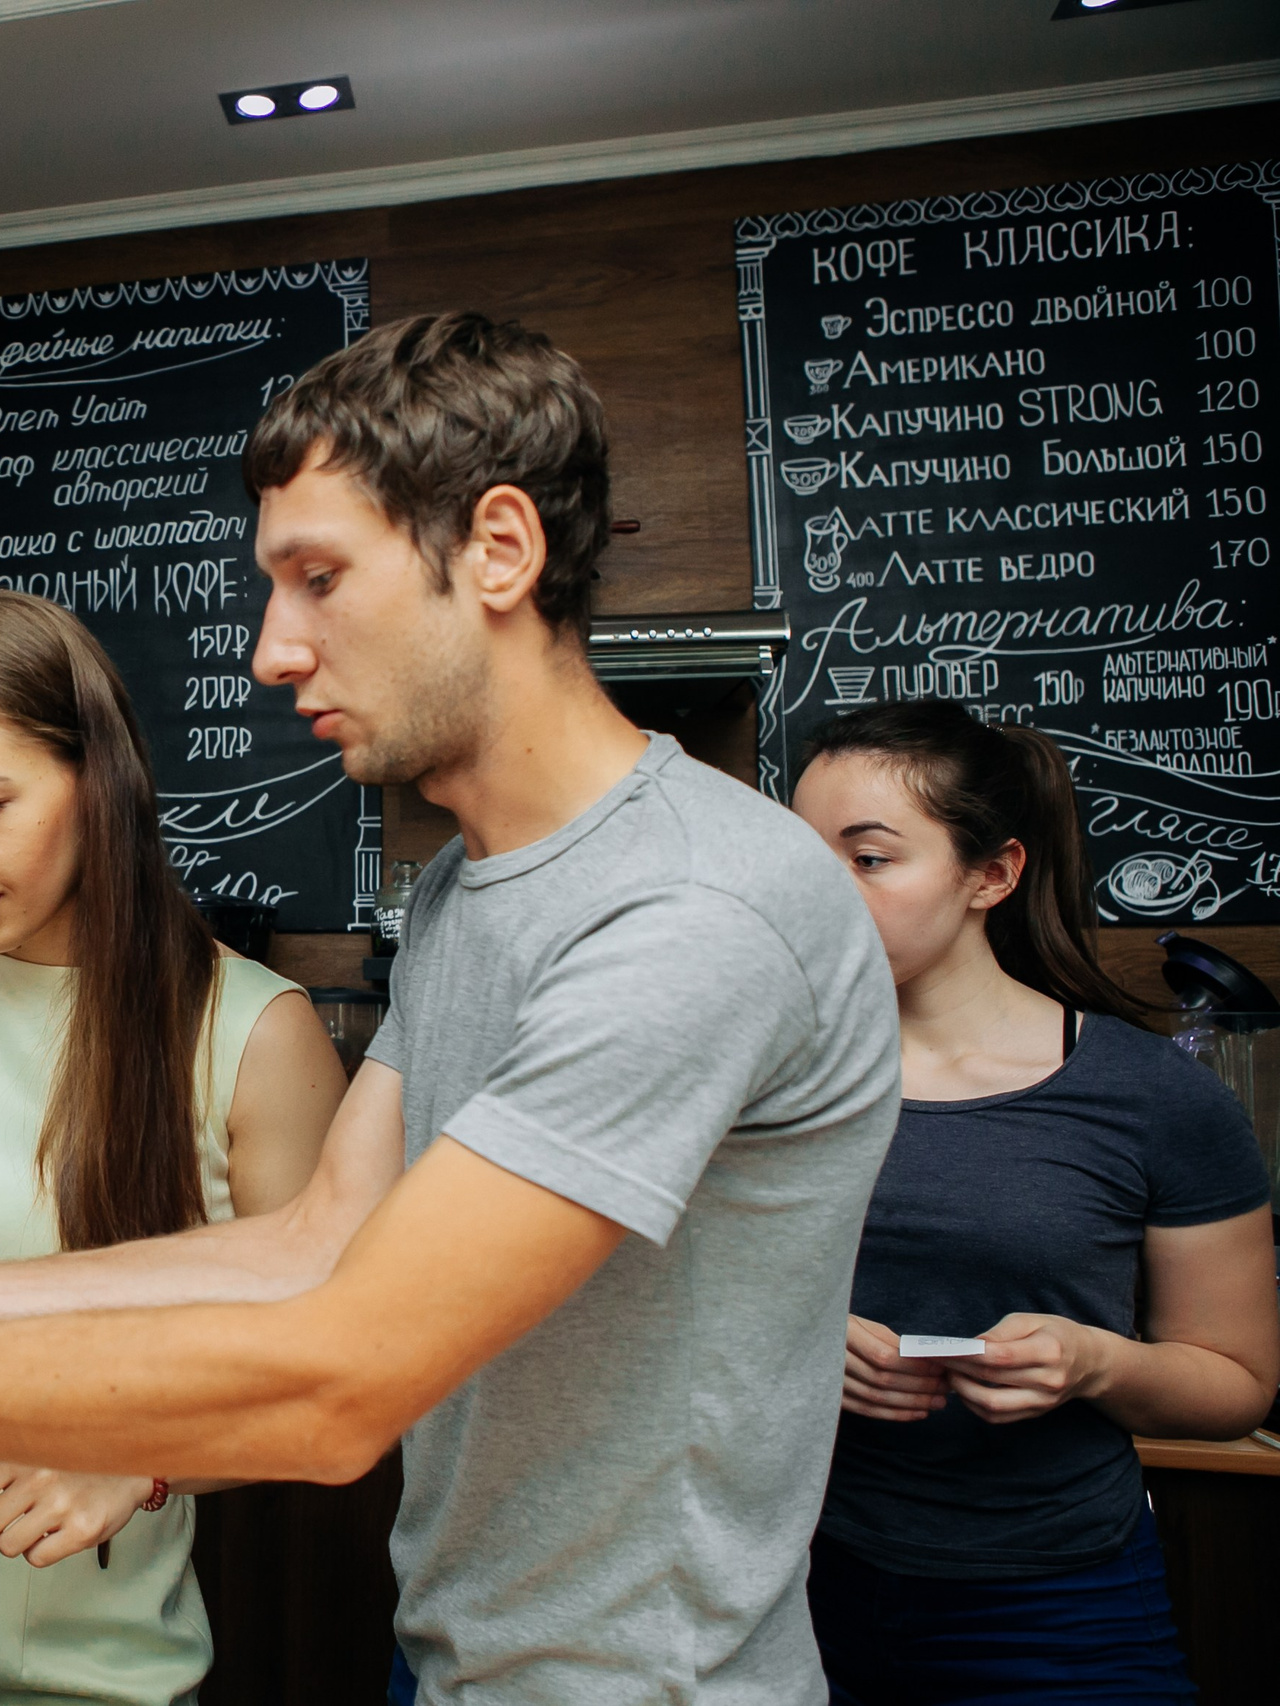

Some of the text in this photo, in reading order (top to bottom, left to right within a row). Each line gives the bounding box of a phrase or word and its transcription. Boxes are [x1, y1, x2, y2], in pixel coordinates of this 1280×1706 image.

[813, 210, 1195, 284] КОФЕ КЛАССИКА:
[1193, 275, 1253, 309] 100
[128, 317, 286, 351] напитки:
[1196, 327, 1256, 361] 100
[260, 374, 295, 407] 12
[1019, 379, 1164, 428] STRONG
[1197, 378, 1260, 414] 120
[71, 395, 147, 426] Уайт
[52, 430, 248, 473] классический
[1202, 431, 1263, 466] 150
[54, 468, 208, 511] авторский
[1207, 485, 1267, 518] 150
[95, 510, 247, 549] шоколадом
[808, 551, 838, 571] 300
[846, 572, 874, 588] 400
[1210, 538, 1270, 569] 170
[154, 557, 248, 617] КОФЕ:
[798, 579, 1247, 665] Альтернатива:
[1103, 643, 1268, 677] АЛЬТЕРНАТИВНЫЙ
[882, 660, 999, 700] ПУРОВЕР
[1103, 674, 1280, 722] КАПУЧИНО 190
[1105, 727, 1243, 752] БЕЗЛАКТОЗНОЕ
[1156, 752, 1252, 776] МОЛОКО
[1088, 796, 1263, 850] Гляссе
